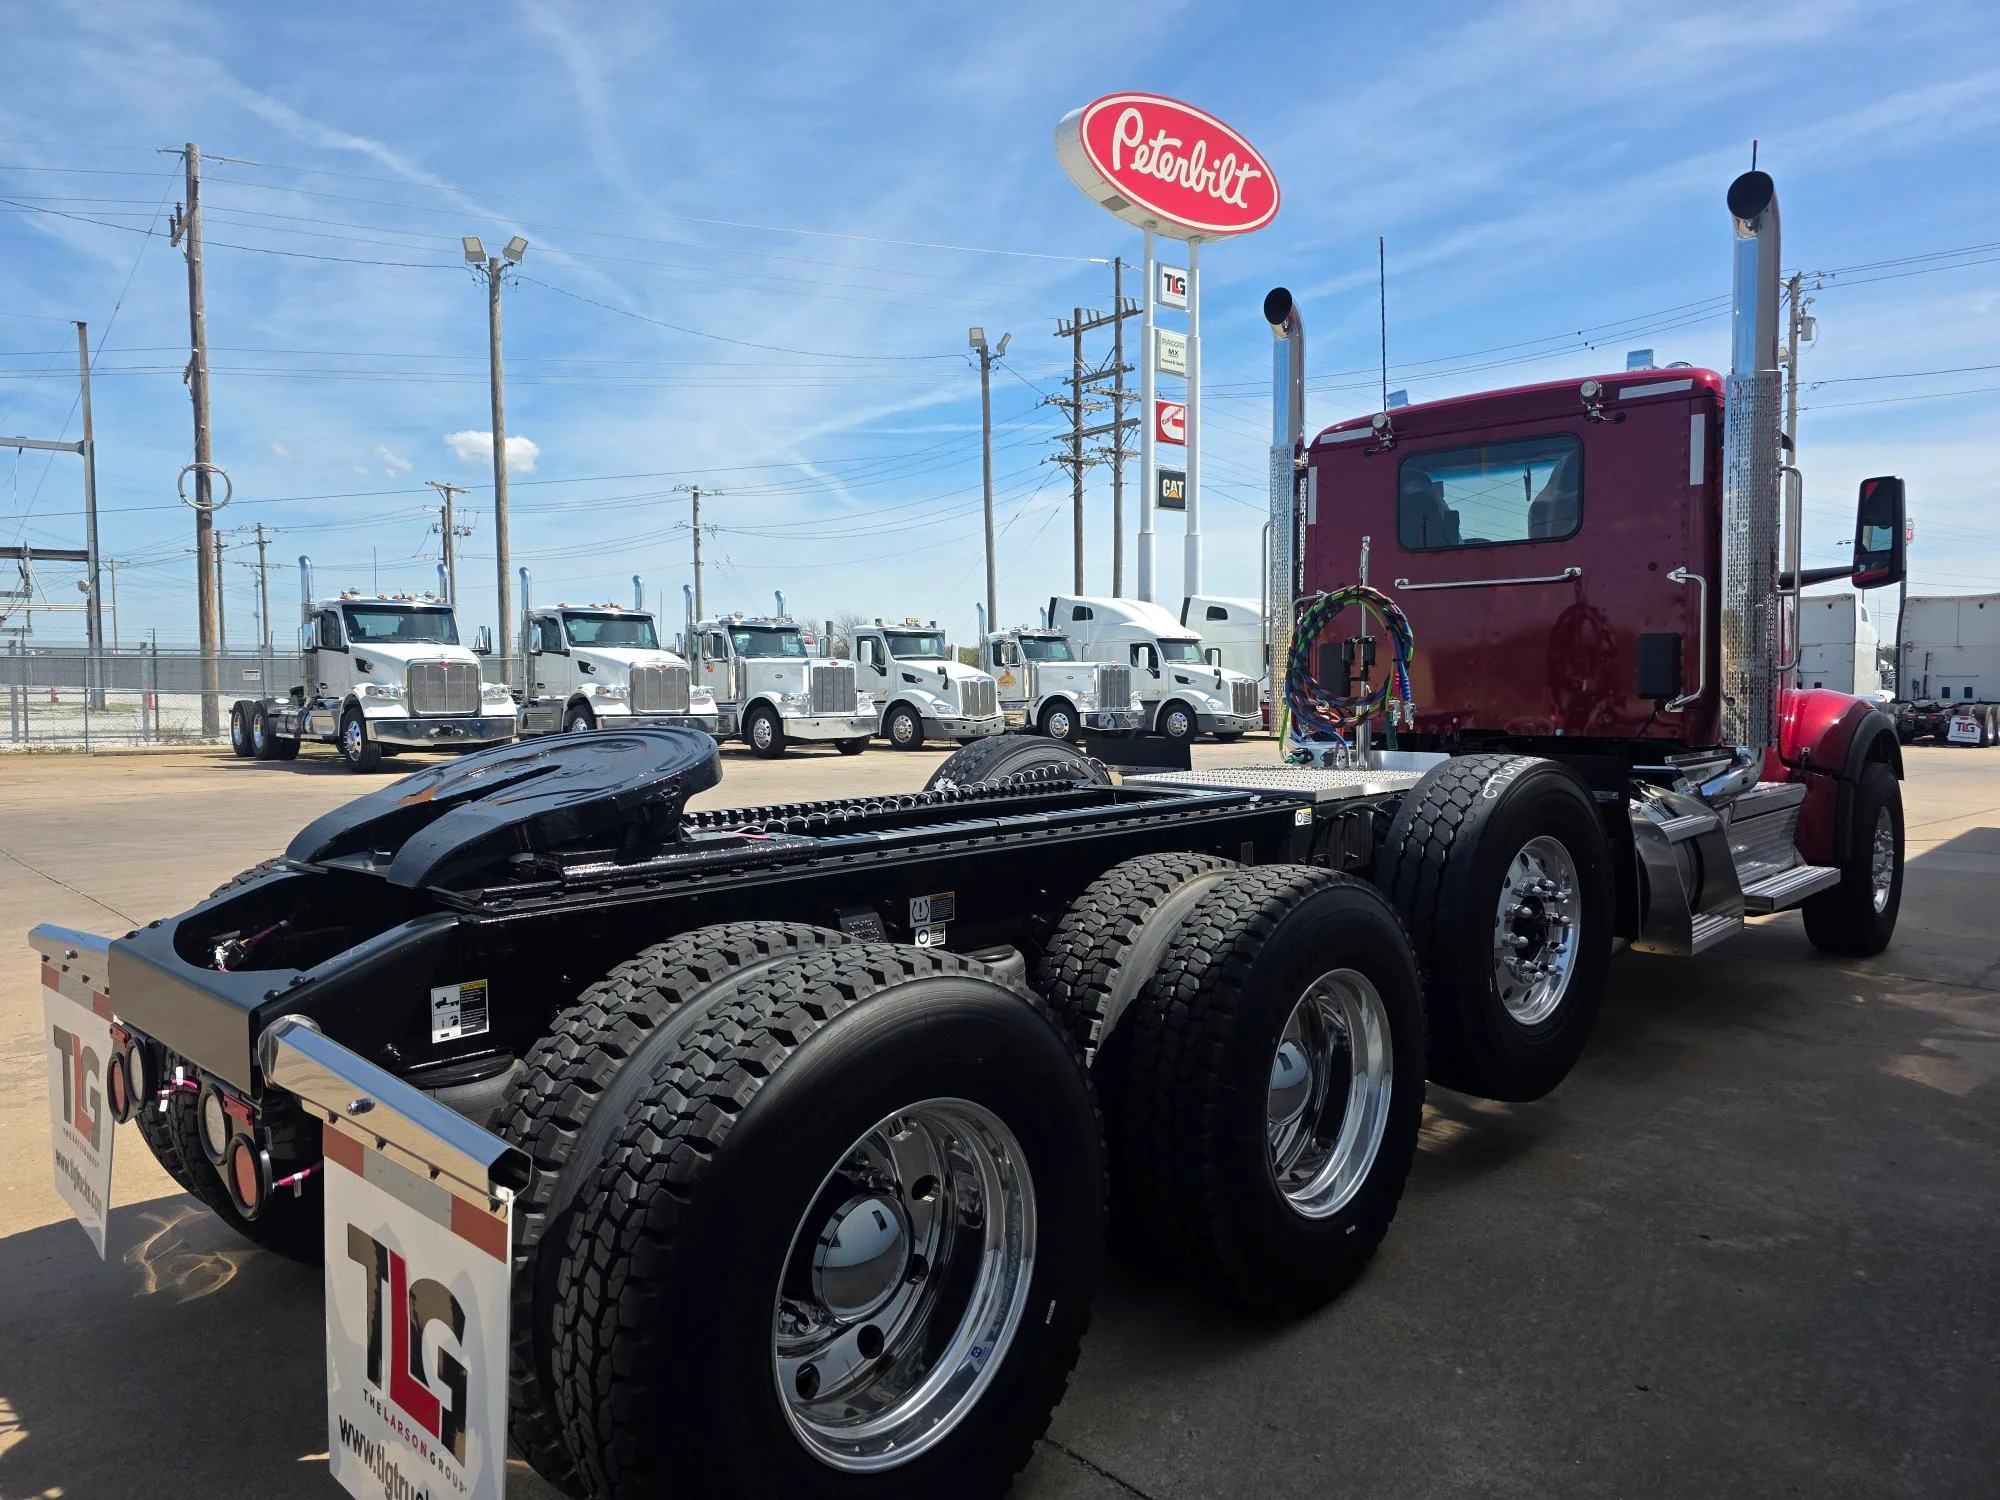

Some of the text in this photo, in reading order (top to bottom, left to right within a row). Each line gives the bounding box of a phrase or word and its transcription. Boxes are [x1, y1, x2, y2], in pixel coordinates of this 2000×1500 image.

[1112, 107, 1262, 209] Peterbilt
[1164, 273, 1186, 295] TLG
[1168, 348, 1179, 356] MX
[1162, 478, 1184, 499] CAT
[1955, 722, 1976, 733] TLG
[53, 1024, 101, 1154] TLG
[347, 1223, 469, 1468] TLG
[363, 1389, 464, 1493] THE LARSON GROUP
